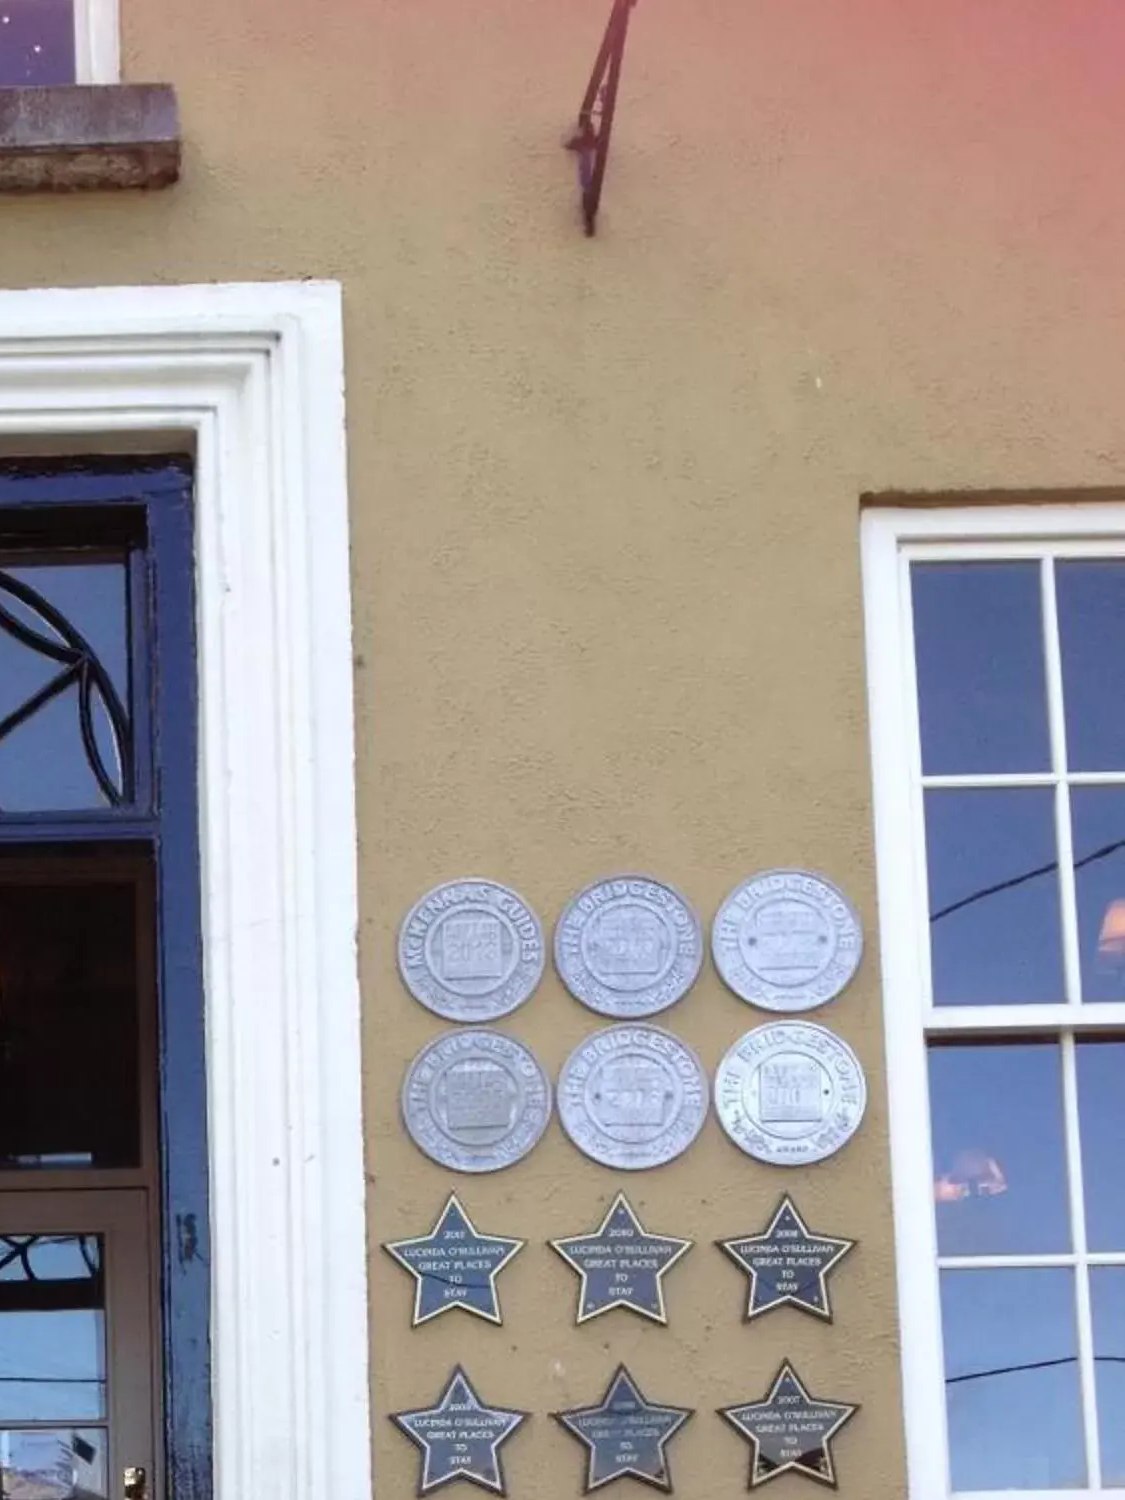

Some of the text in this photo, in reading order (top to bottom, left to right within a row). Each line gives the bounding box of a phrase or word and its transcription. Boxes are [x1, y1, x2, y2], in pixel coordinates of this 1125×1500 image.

[498, 892, 540, 962] GUIDES
[565, 1061, 588, 1106] THE
[582, 1031, 701, 1109] BRIDGESTONE
[570, 1245, 612, 1255] LUCINDA
[418, 1260, 491, 1271] GREAT PLACES
[583, 1259, 658, 1269] GREAT PLACES
[753, 1257, 822, 1267] GREAT PLACES
[449, 1275, 463, 1284] TO
[615, 1273, 629, 1282] TO
[781, 1270, 795, 1279] TO
[427, 1431, 456, 1440] GREAT
